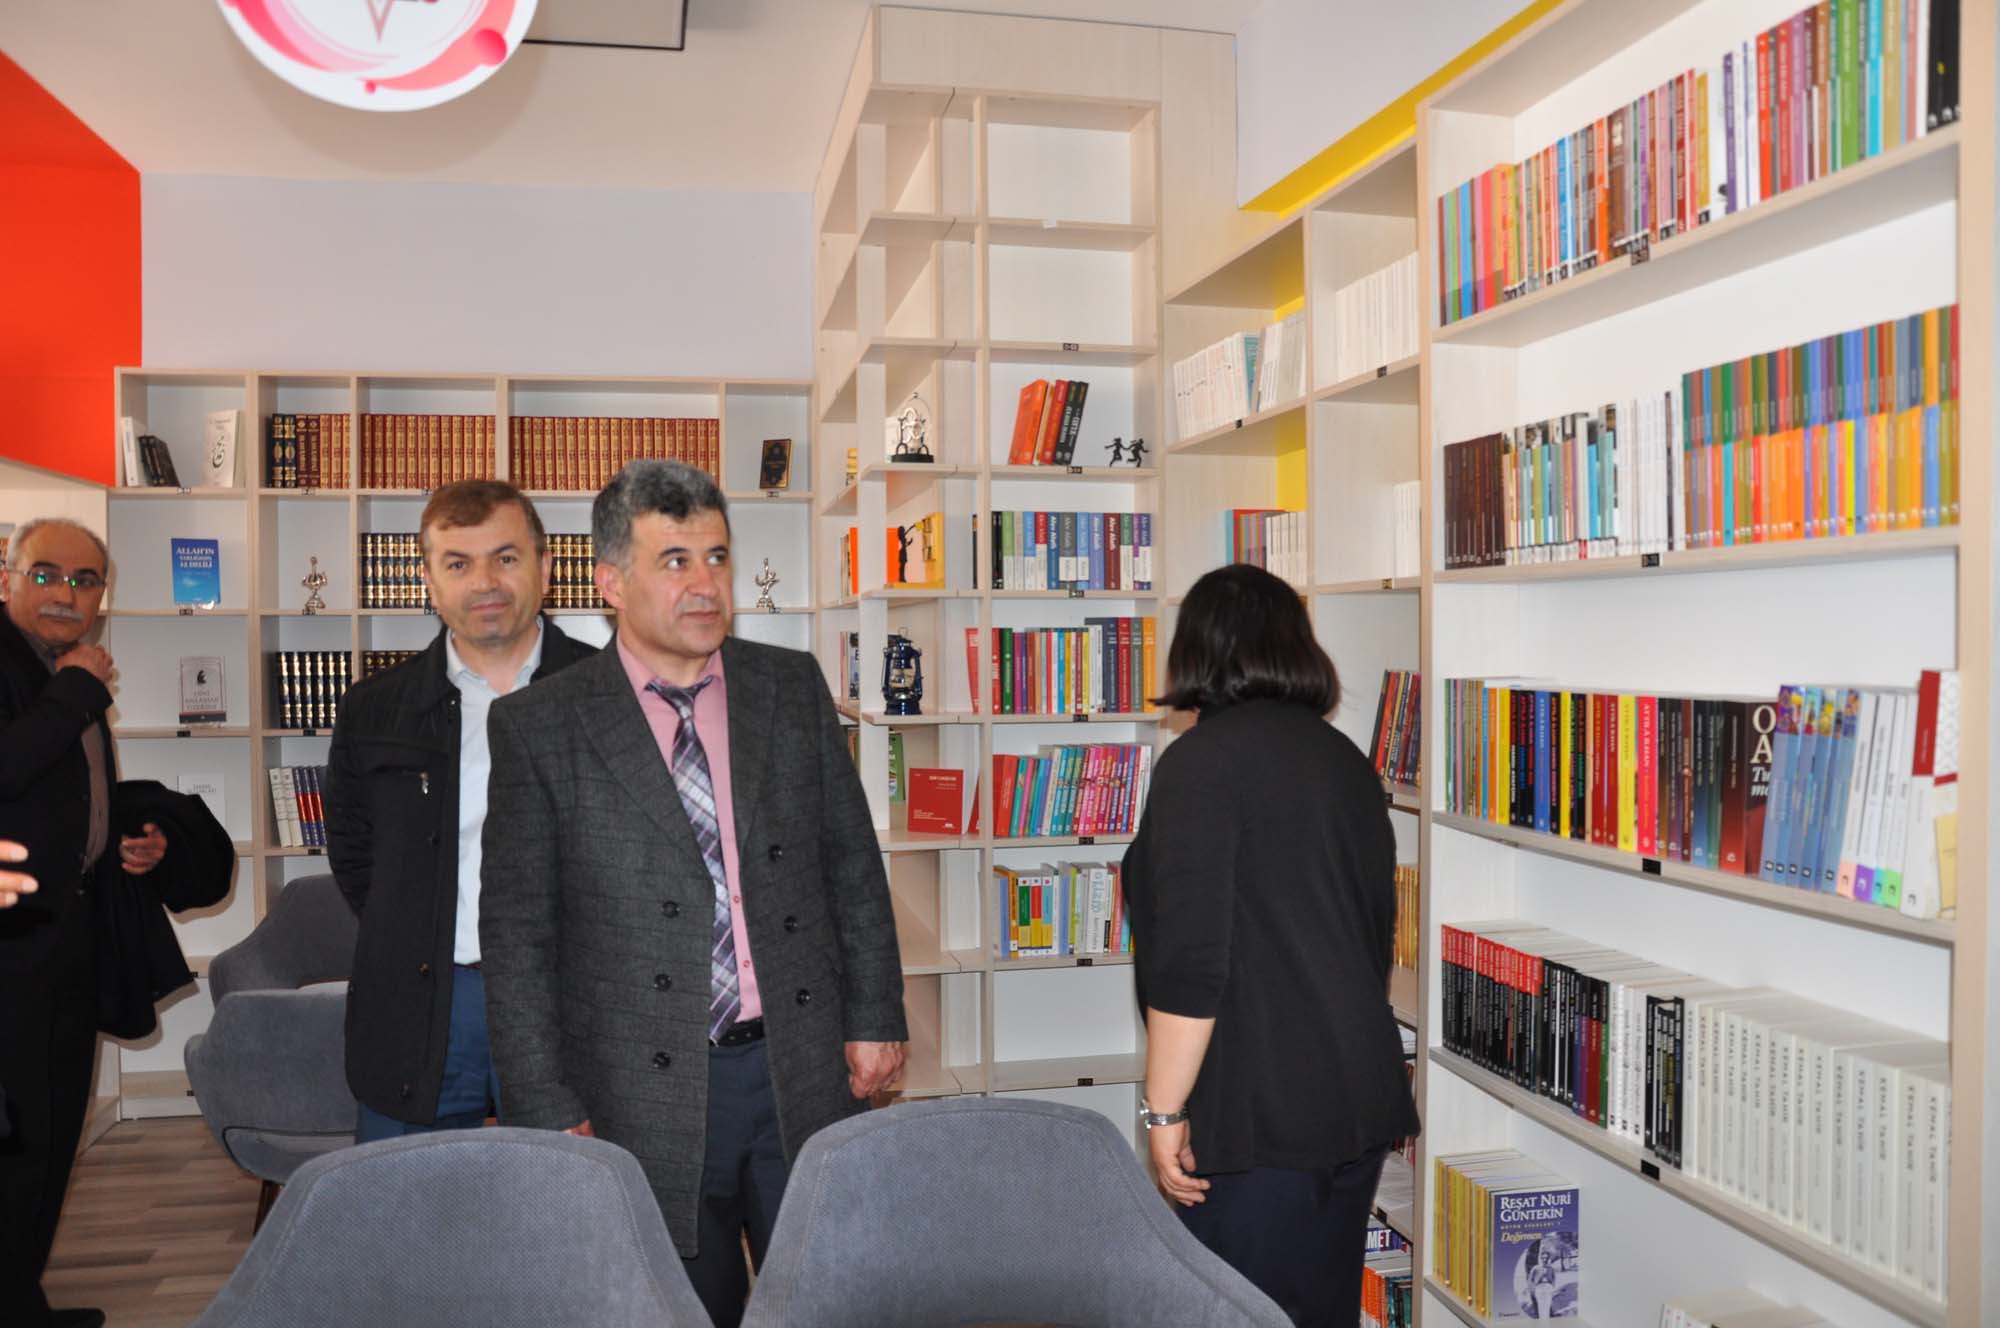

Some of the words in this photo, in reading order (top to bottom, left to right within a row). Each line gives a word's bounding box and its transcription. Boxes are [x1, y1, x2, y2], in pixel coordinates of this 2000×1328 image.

[1501, 1197, 1537, 1211] REŞAT
[1541, 1193, 1571, 1206] NURİ
[1500, 1206, 1563, 1222] GÜNTEKİN
[1366, 1229, 1392, 1249] MET
